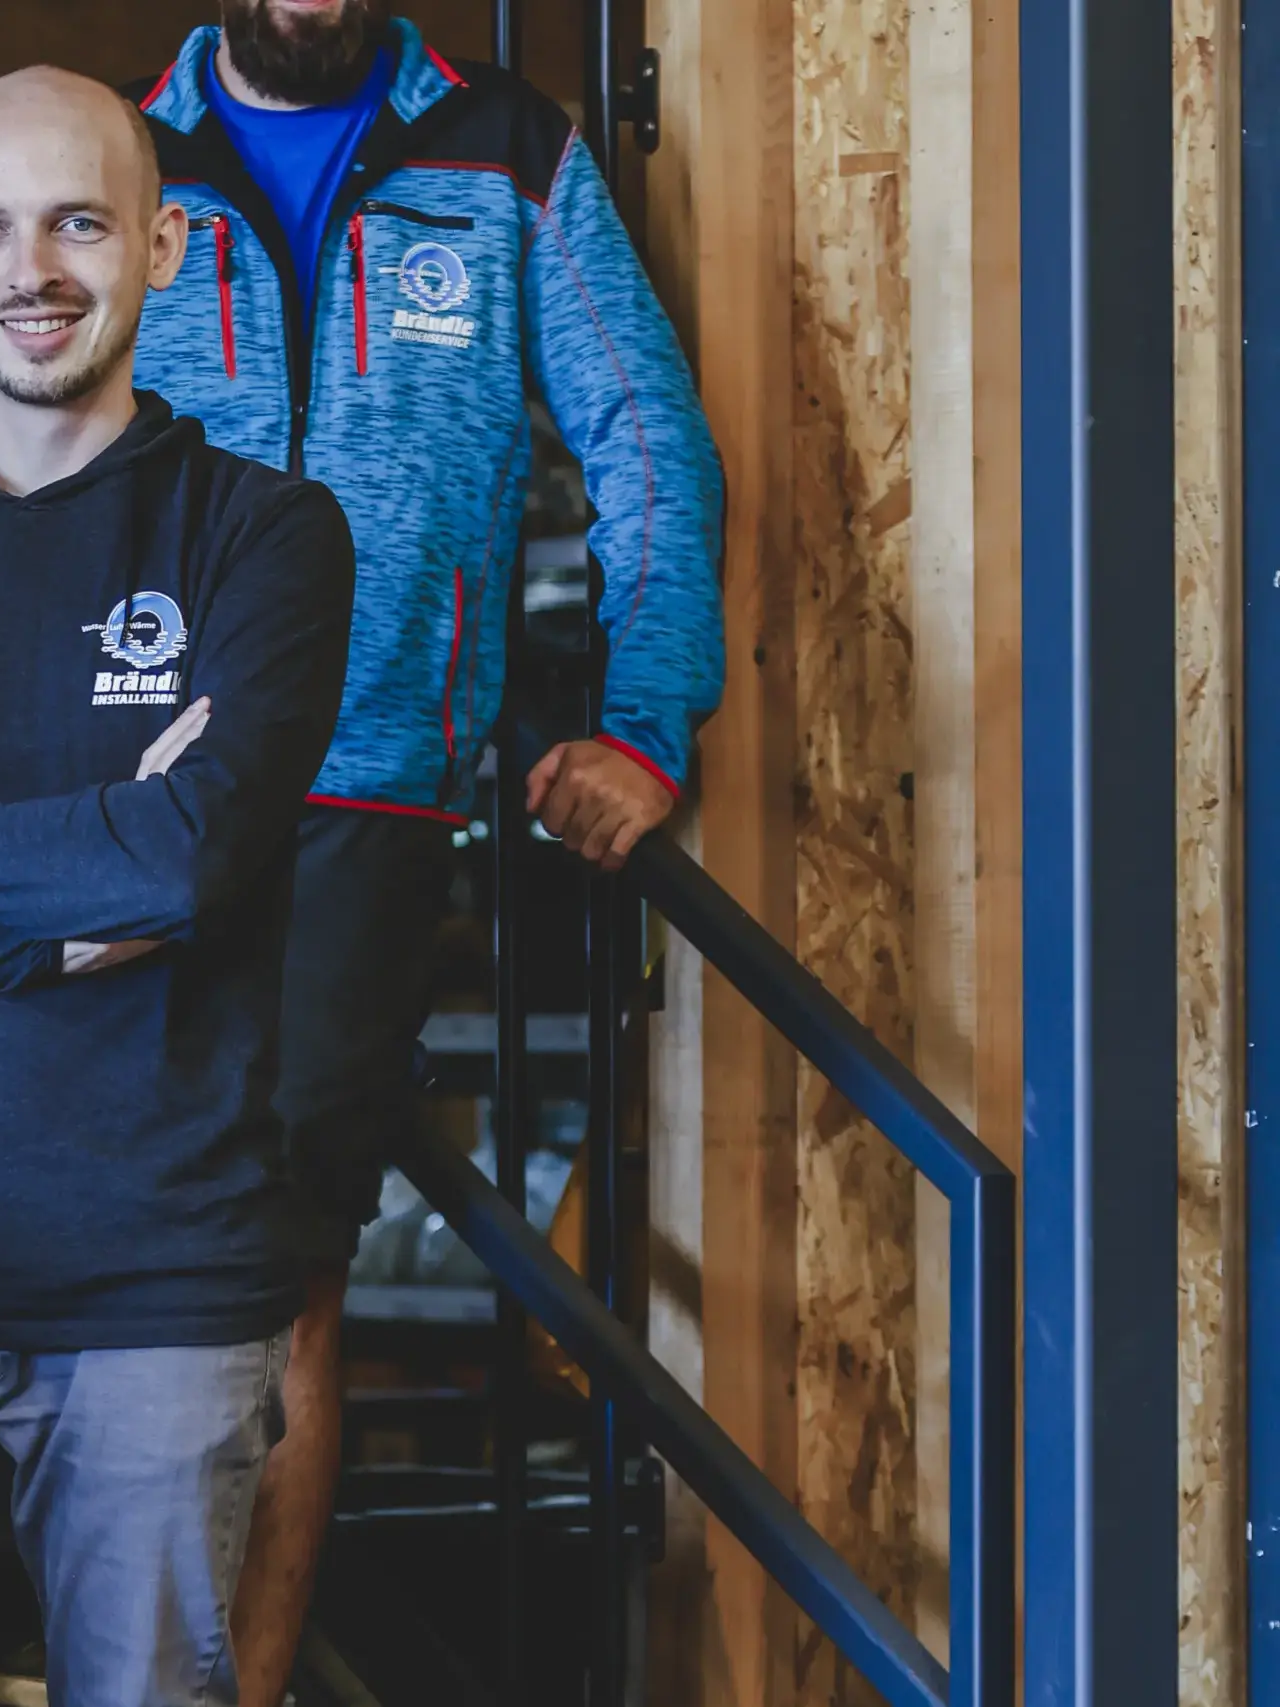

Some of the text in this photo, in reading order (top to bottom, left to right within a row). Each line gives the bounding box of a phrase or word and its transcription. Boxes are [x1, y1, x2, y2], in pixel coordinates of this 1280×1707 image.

[393, 309, 475, 336] Brändle
[81, 621, 107, 632] Wasser
[129, 621, 156, 630] Wärme
[91, 693, 178, 706] INSTALLATION
